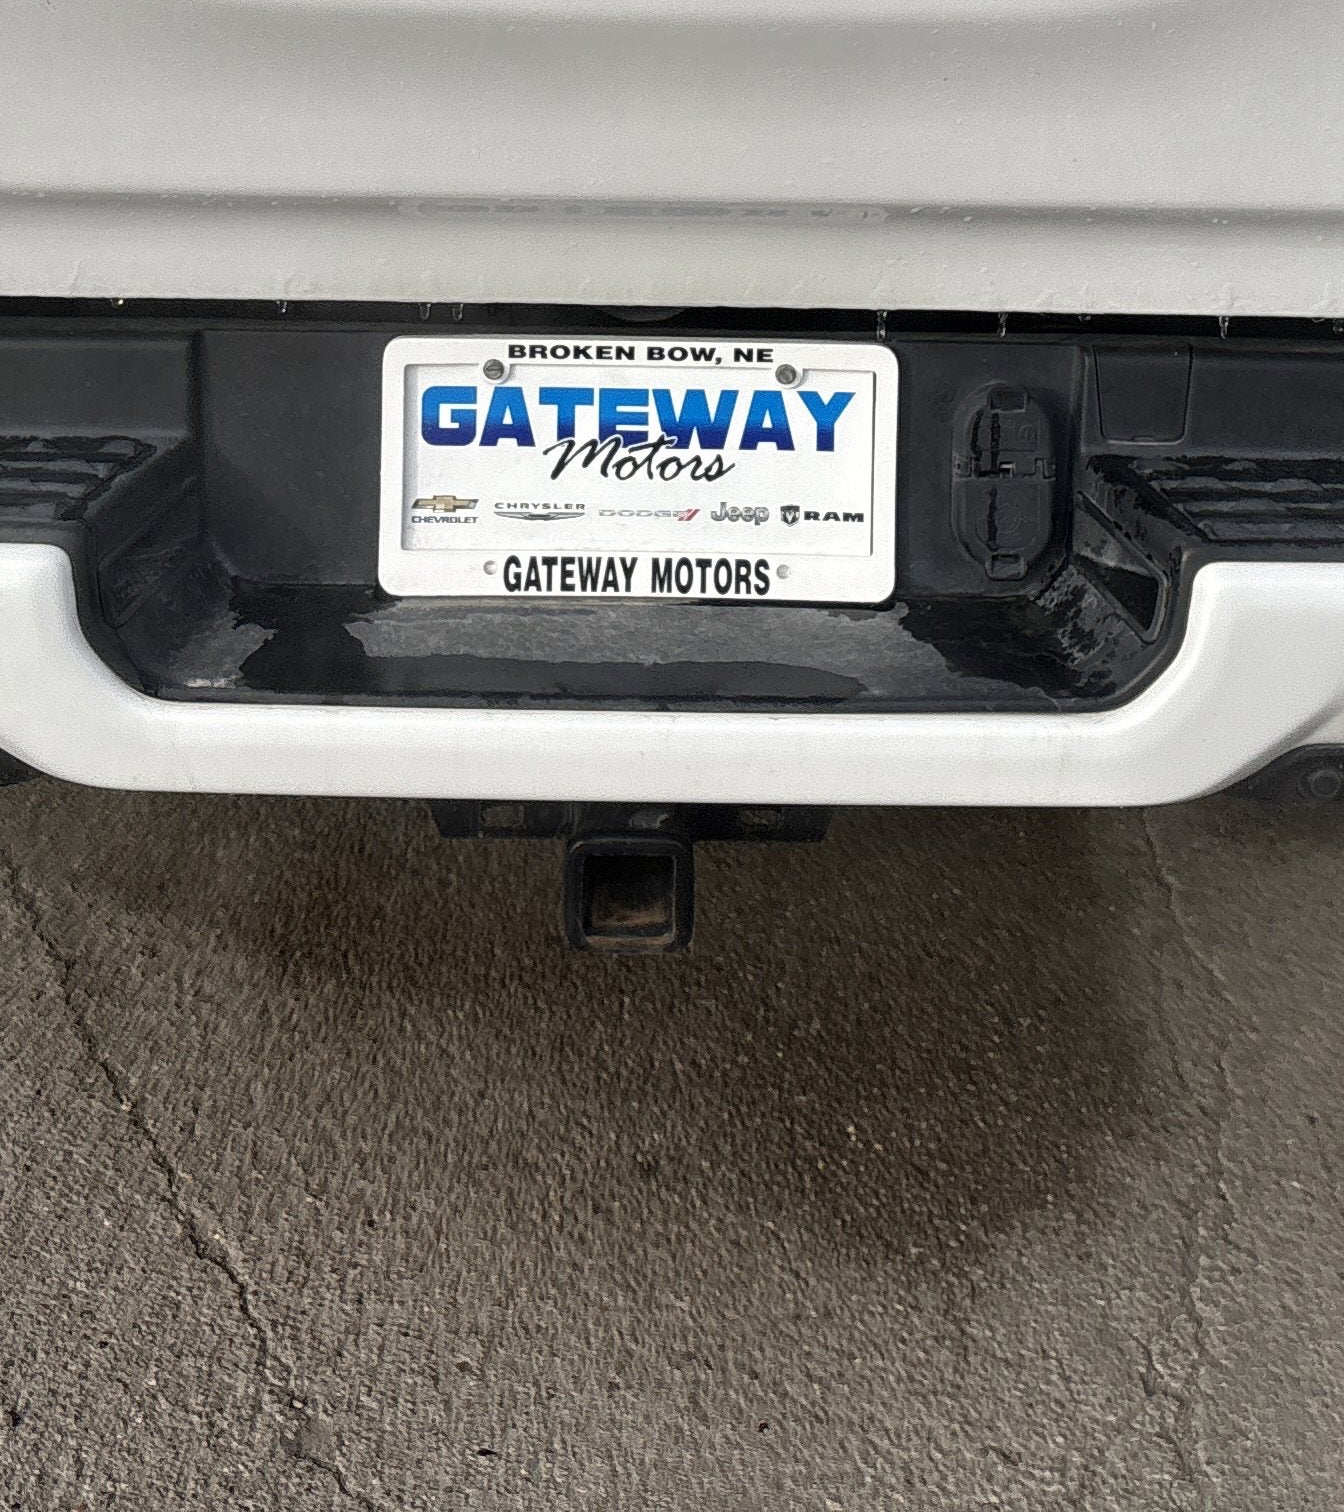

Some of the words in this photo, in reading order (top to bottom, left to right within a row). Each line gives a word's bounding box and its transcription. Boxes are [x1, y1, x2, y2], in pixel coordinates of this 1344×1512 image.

[508, 344, 636, 360] BROKEN
[646, 346, 723, 365] BOW,
[733, 348, 774, 363] NE
[421, 385, 856, 452] GATEWAY
[542, 433, 736, 482] Motors
[493, 502, 586, 510] CHRYSLER
[711, 501, 770, 525] Jeep
[803, 510, 865, 522] RAM
[411, 515, 479, 524] CHEVROLET
[503, 554, 639, 593] GATEWAY
[650, 556, 771, 596] MOTORS
